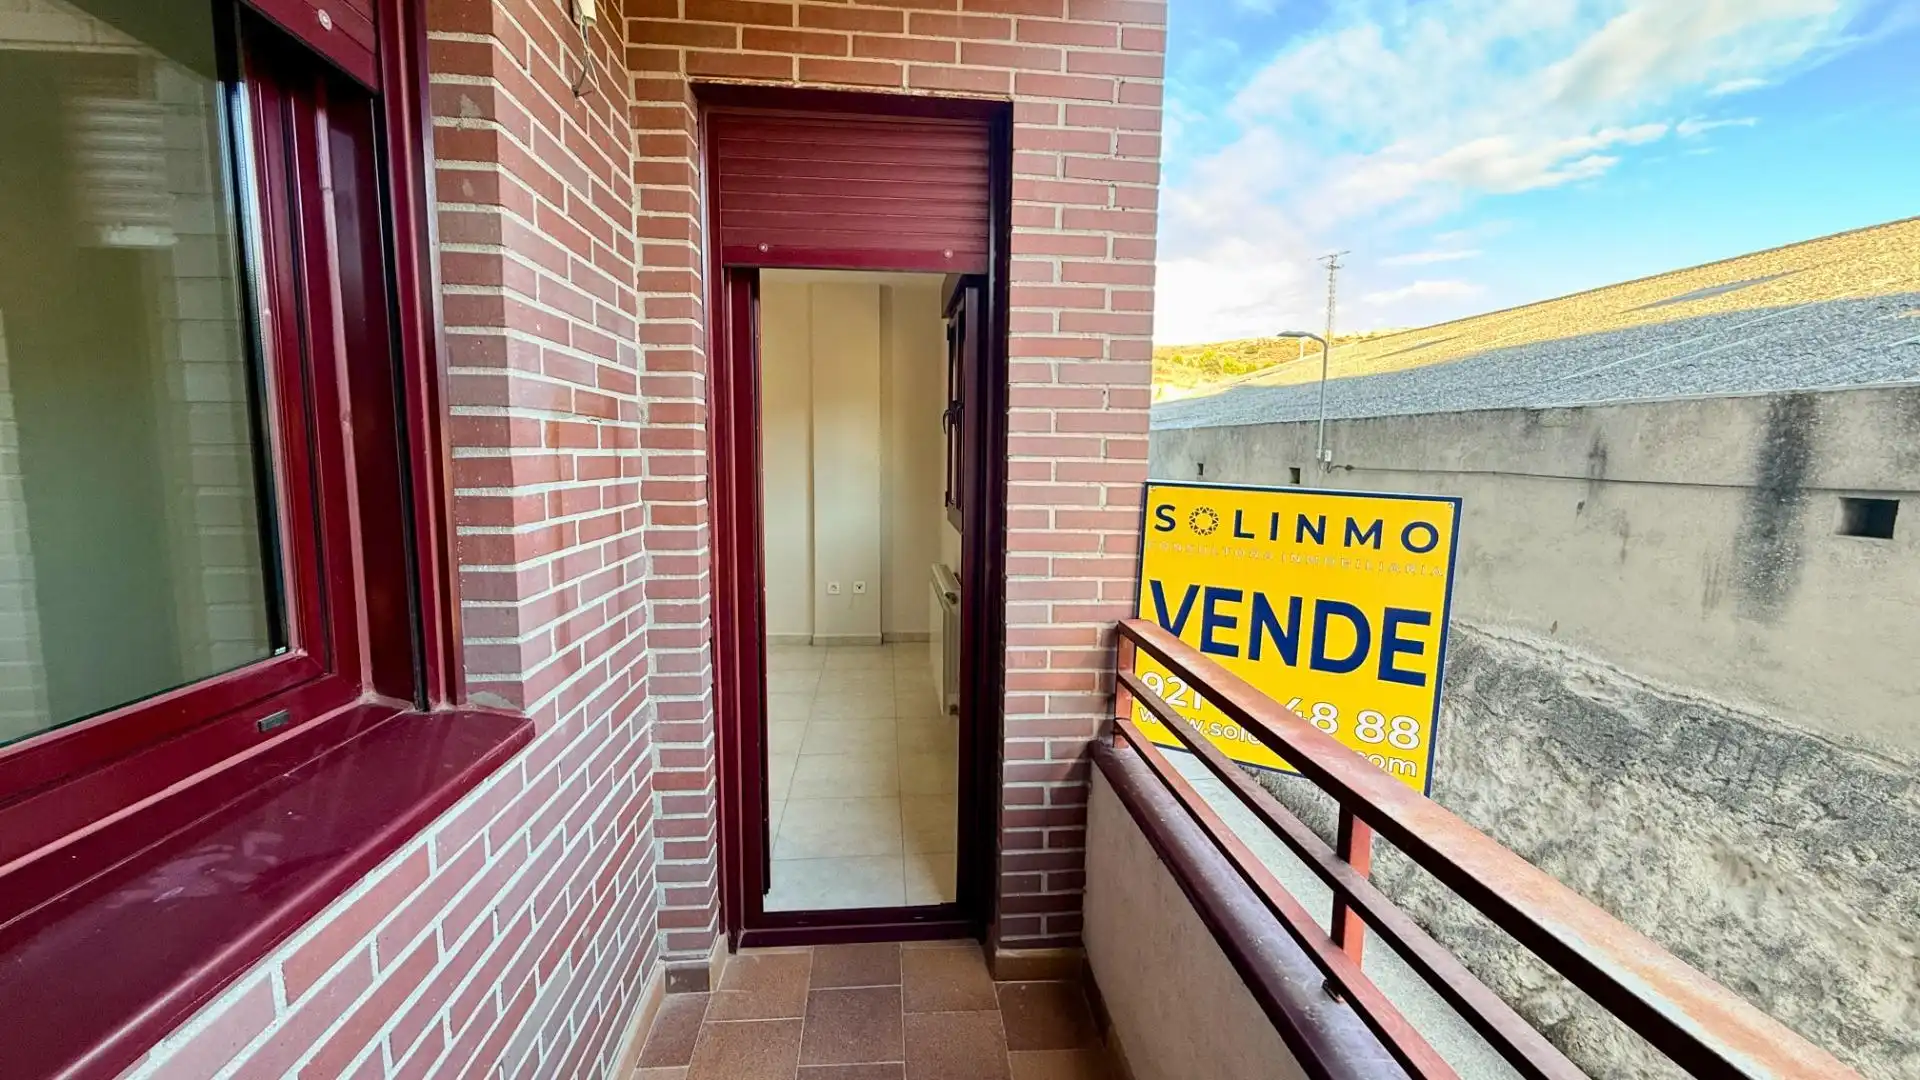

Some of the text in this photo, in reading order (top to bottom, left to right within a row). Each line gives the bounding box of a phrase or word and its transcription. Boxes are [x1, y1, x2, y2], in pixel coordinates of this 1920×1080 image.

[1154, 504, 1439, 554] SOLINMO
[1149, 579, 1432, 687] VENDE
[1354, 709, 1420, 750] 88
